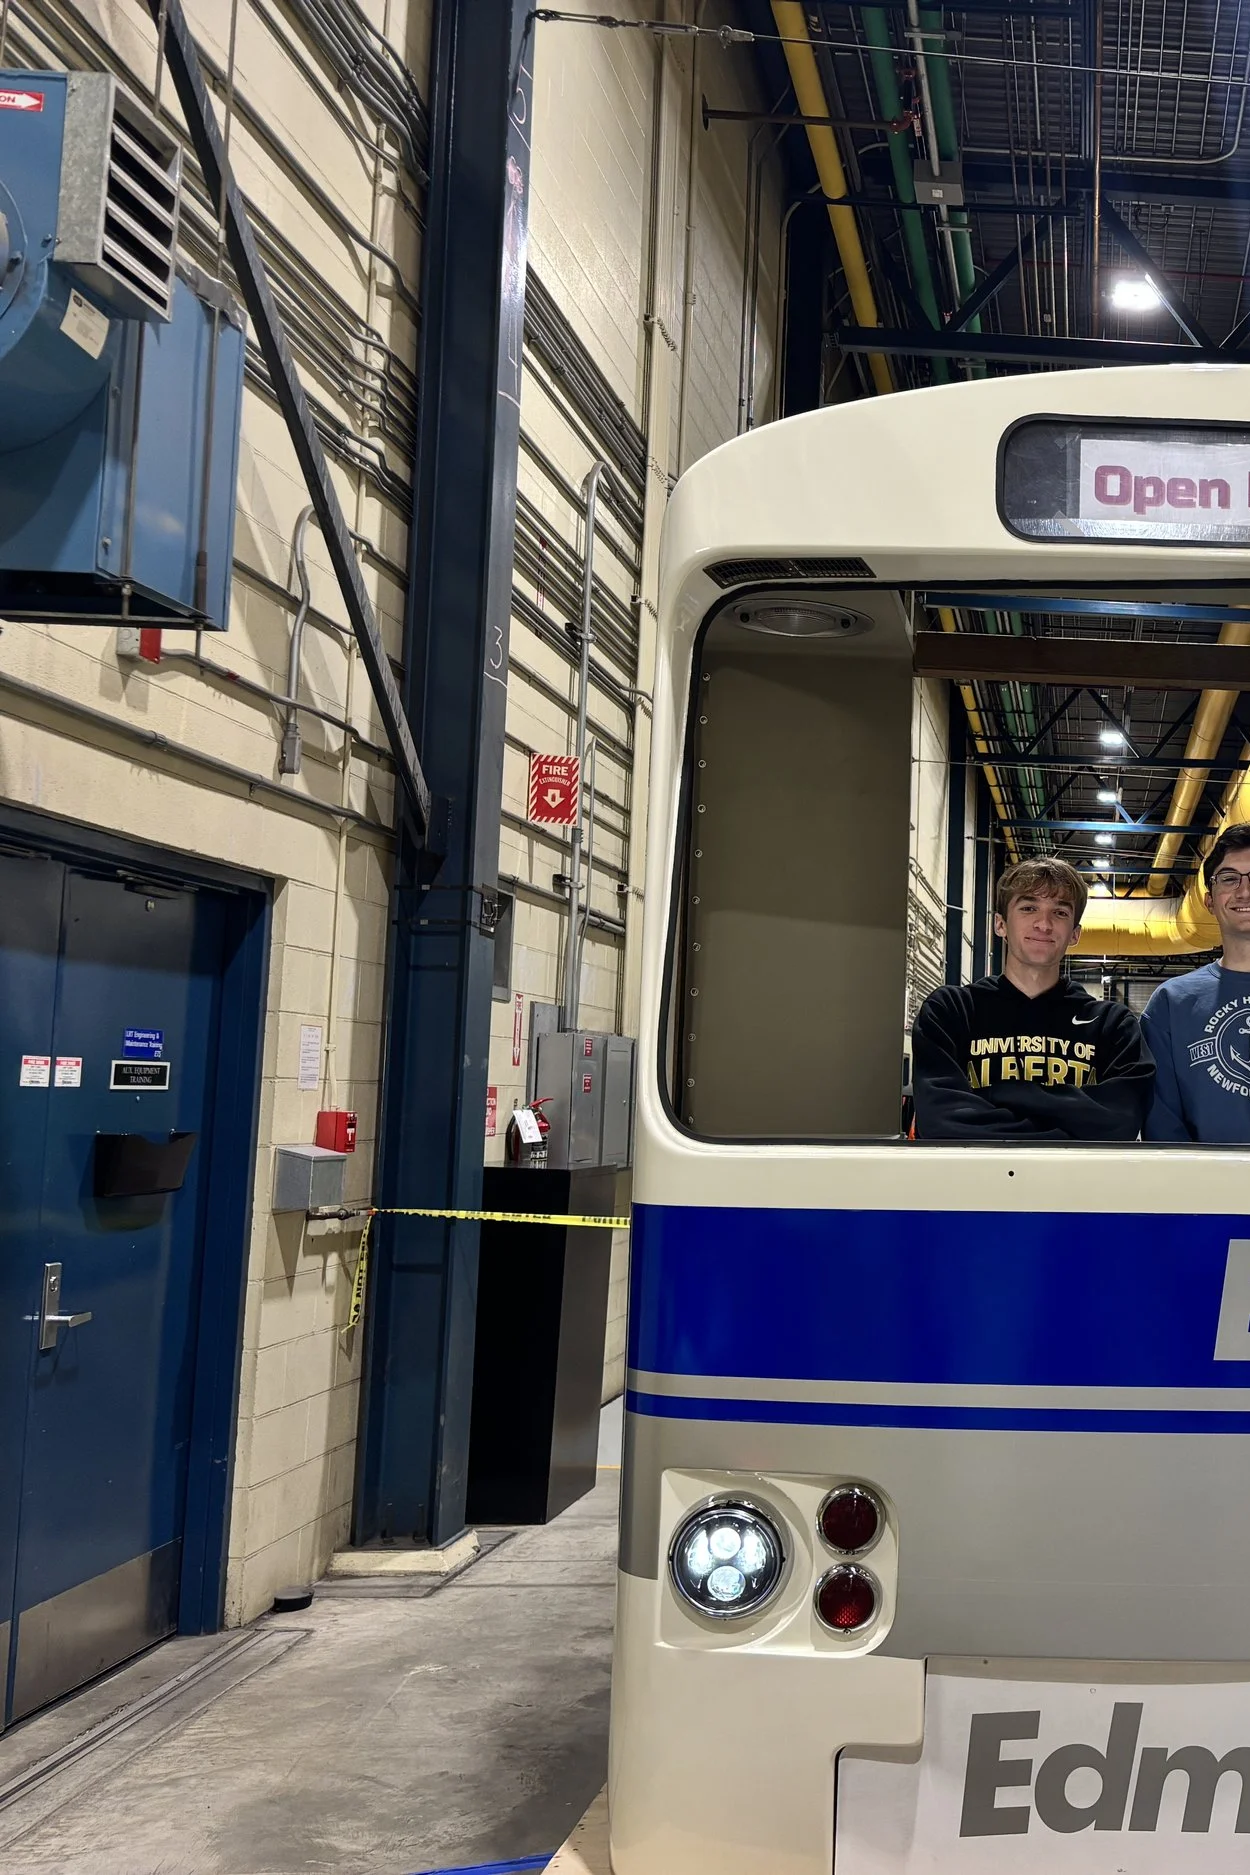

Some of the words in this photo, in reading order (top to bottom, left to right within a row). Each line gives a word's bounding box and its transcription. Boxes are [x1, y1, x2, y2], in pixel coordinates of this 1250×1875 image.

[1094, 465, 1231, 515] Open
[542, 765, 569, 776] FIRE
[539, 776, 571, 786] EXTINGUISHER
[1204, 999, 1239, 1033] ROCKY
[134, 1031, 155, 1040] Engineering
[125, 1040, 148, 1048] Maintenance
[149, 1041, 162, 1050] Training
[1073, 1041, 1096, 1061] OF
[1189, 1041, 1214, 1062] WEST
[134, 1067, 160, 1075] EQUIPMENT
[130, 1075, 152, 1083] TRAINING
